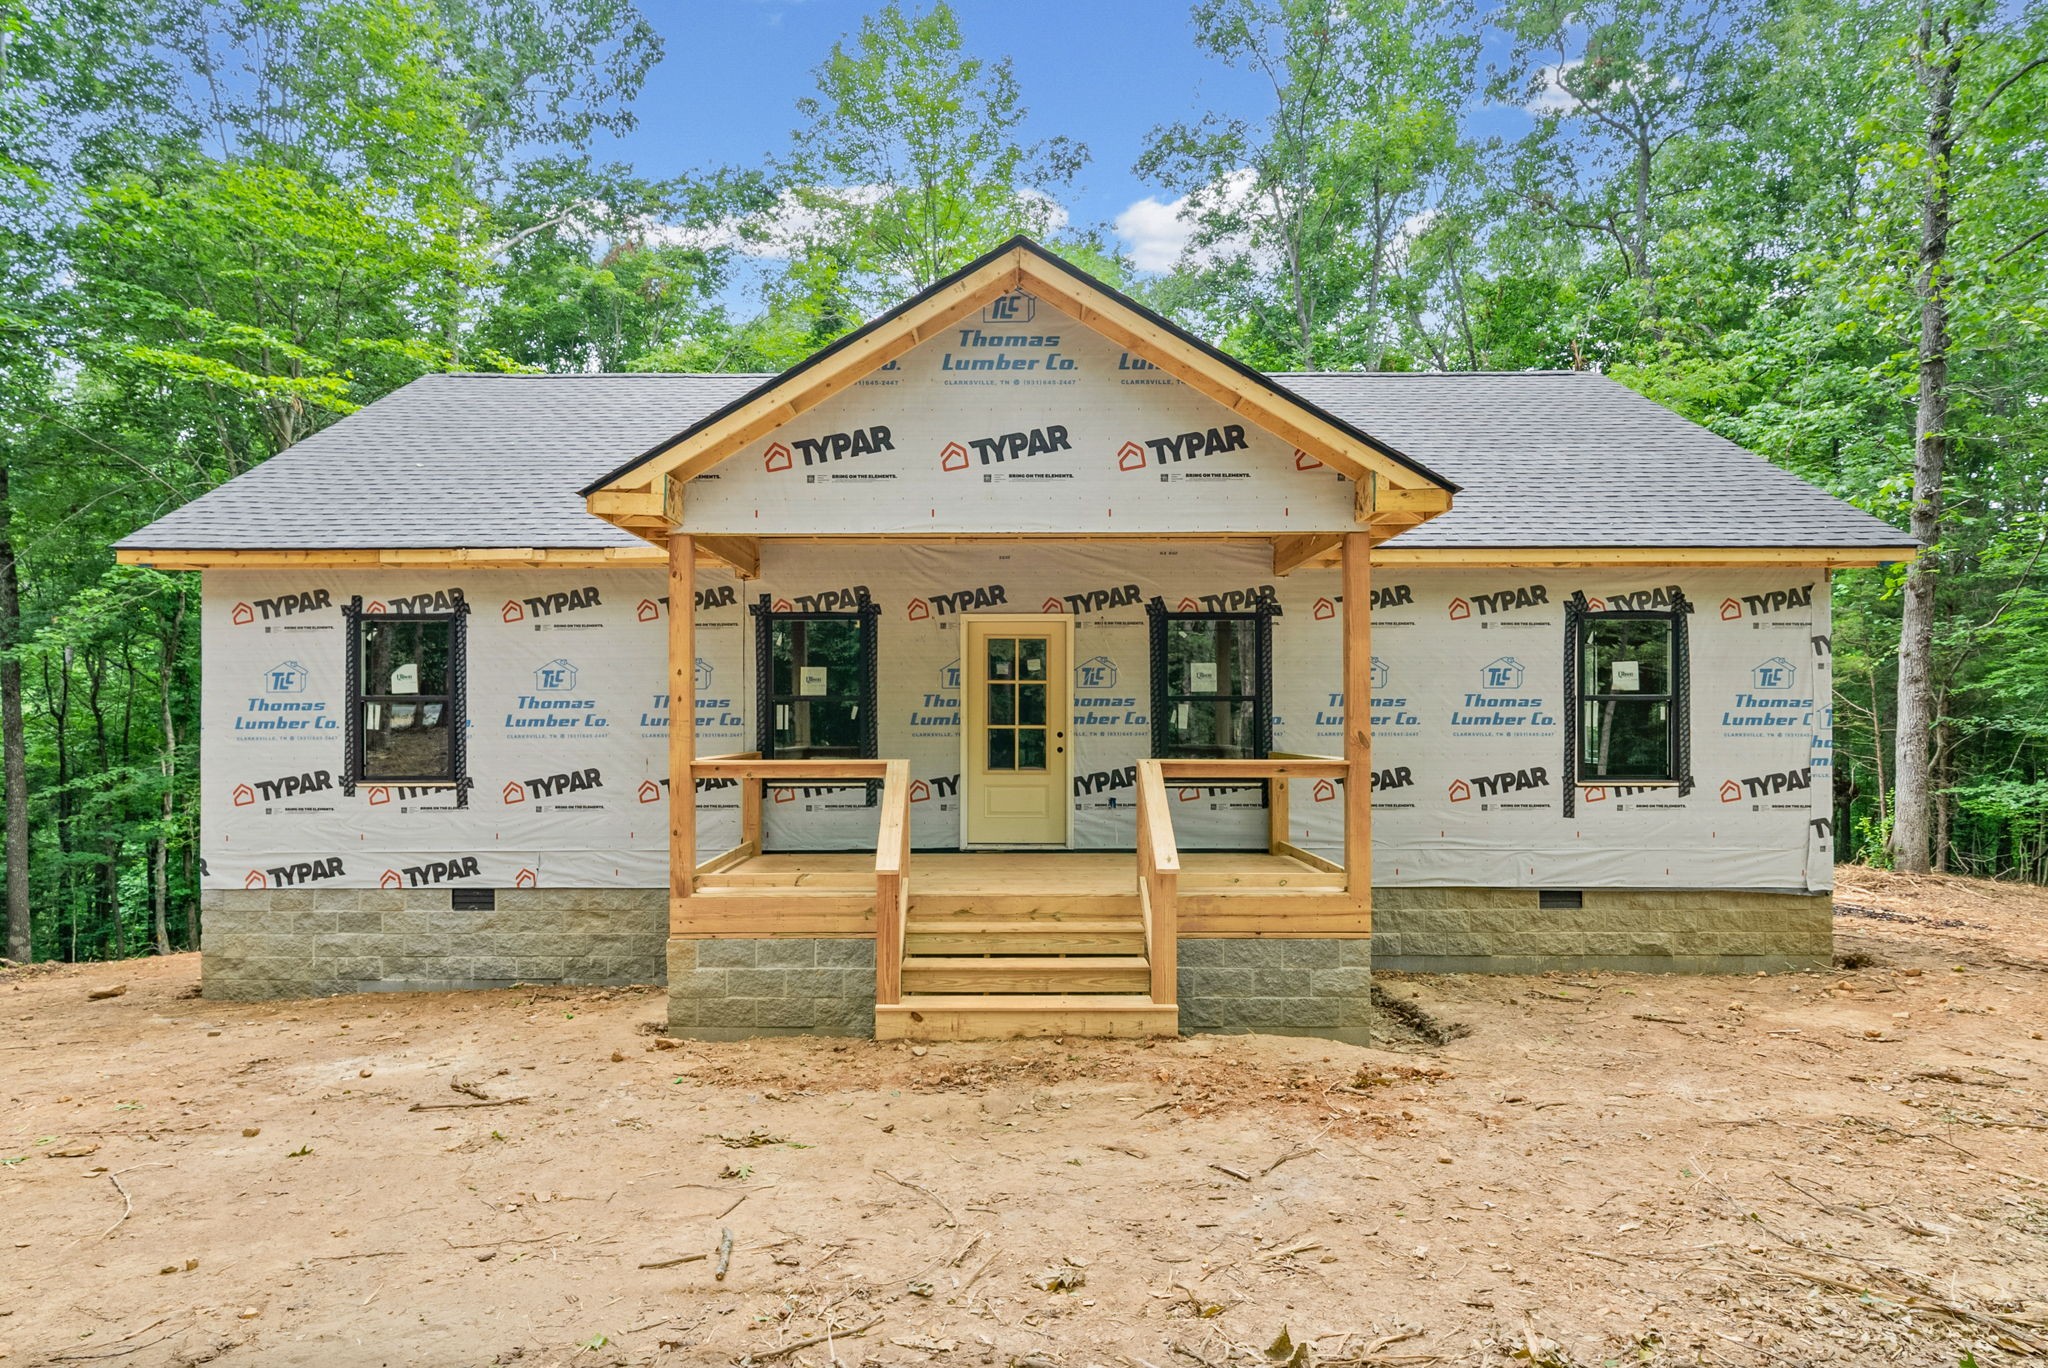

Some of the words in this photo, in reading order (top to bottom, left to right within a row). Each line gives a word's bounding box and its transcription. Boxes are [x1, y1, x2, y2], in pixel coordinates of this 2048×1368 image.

[959, 330, 1060, 347] Thomas
[942, 354, 1040, 370] Lumber
[1046, 354, 1078, 370] Co.
[792, 426, 895, 466] TYPAR
[968, 424, 1072, 465] TYPAR
[1145, 424, 1249, 464] TYPAR
[254, 589, 332, 619] TYPAR
[523, 586, 602, 617] TYPAR
[928, 584, 1008, 616] TYPAR
[1064, 584, 1143, 615] TYPAR
[1470, 585, 1549, 615] TYPAR
[272, 672, 294, 690] TLC
[542, 670, 565, 688] TLC
[1082, 668, 1105, 685] TLC
[1489, 668, 1512, 686] TLC
[1759, 668, 1783, 686] TLC
[248, 698, 326, 712] Thomas
[518, 696, 595, 709] Thomas
[1464, 694, 1542, 707] Thomas
[1736, 694, 1813, 708] Thomas
[234, 716, 311, 729] Lumber
[314, 716, 339, 729] Co.
[505, 714, 580, 727] Lumber
[585, 714, 610, 727] Co.
[720, 713, 744, 726] Co.
[1125, 712, 1149, 724] Co.
[1395, 712, 1420, 725] Co.
[1451, 712, 1526, 726] Lumber
[1531, 712, 1557, 726] Co.
[1722, 712, 1798, 726] Lumber
[254, 770, 333, 801] TYPAR
[524, 768, 603, 799] TYPAR
[1470, 766, 1550, 797] TYPAR
[266, 857, 346, 887] TYPAR
[402, 856, 481, 887] TYPAR
